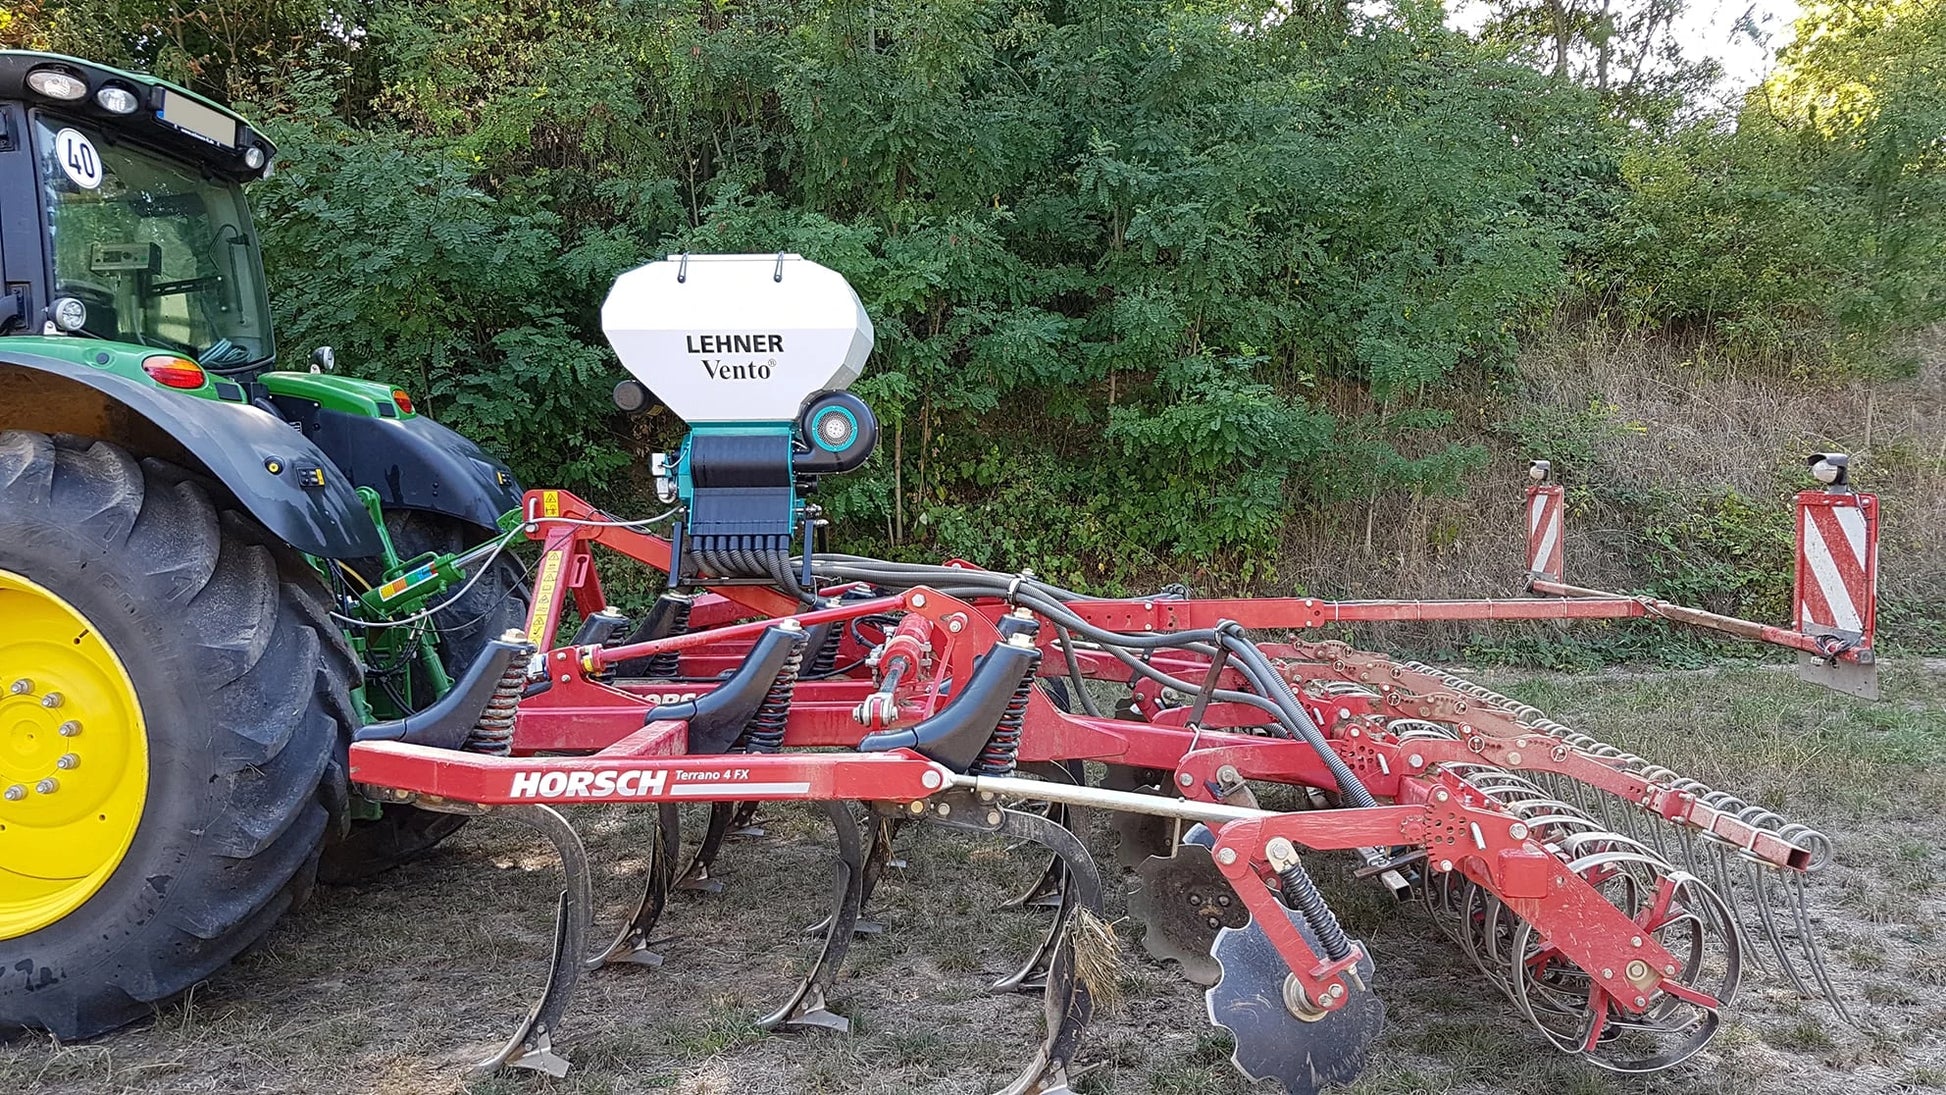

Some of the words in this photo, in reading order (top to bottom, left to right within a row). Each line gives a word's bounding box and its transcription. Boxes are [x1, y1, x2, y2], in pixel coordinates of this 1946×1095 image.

[67, 138, 95, 179] 40
[686, 334, 784, 353] LEHNER
[510, 769, 668, 798] HORSCH
[675, 769, 720, 780] Terrano
[723, 769, 731, 780] 4
[734, 769, 750, 780] FX
